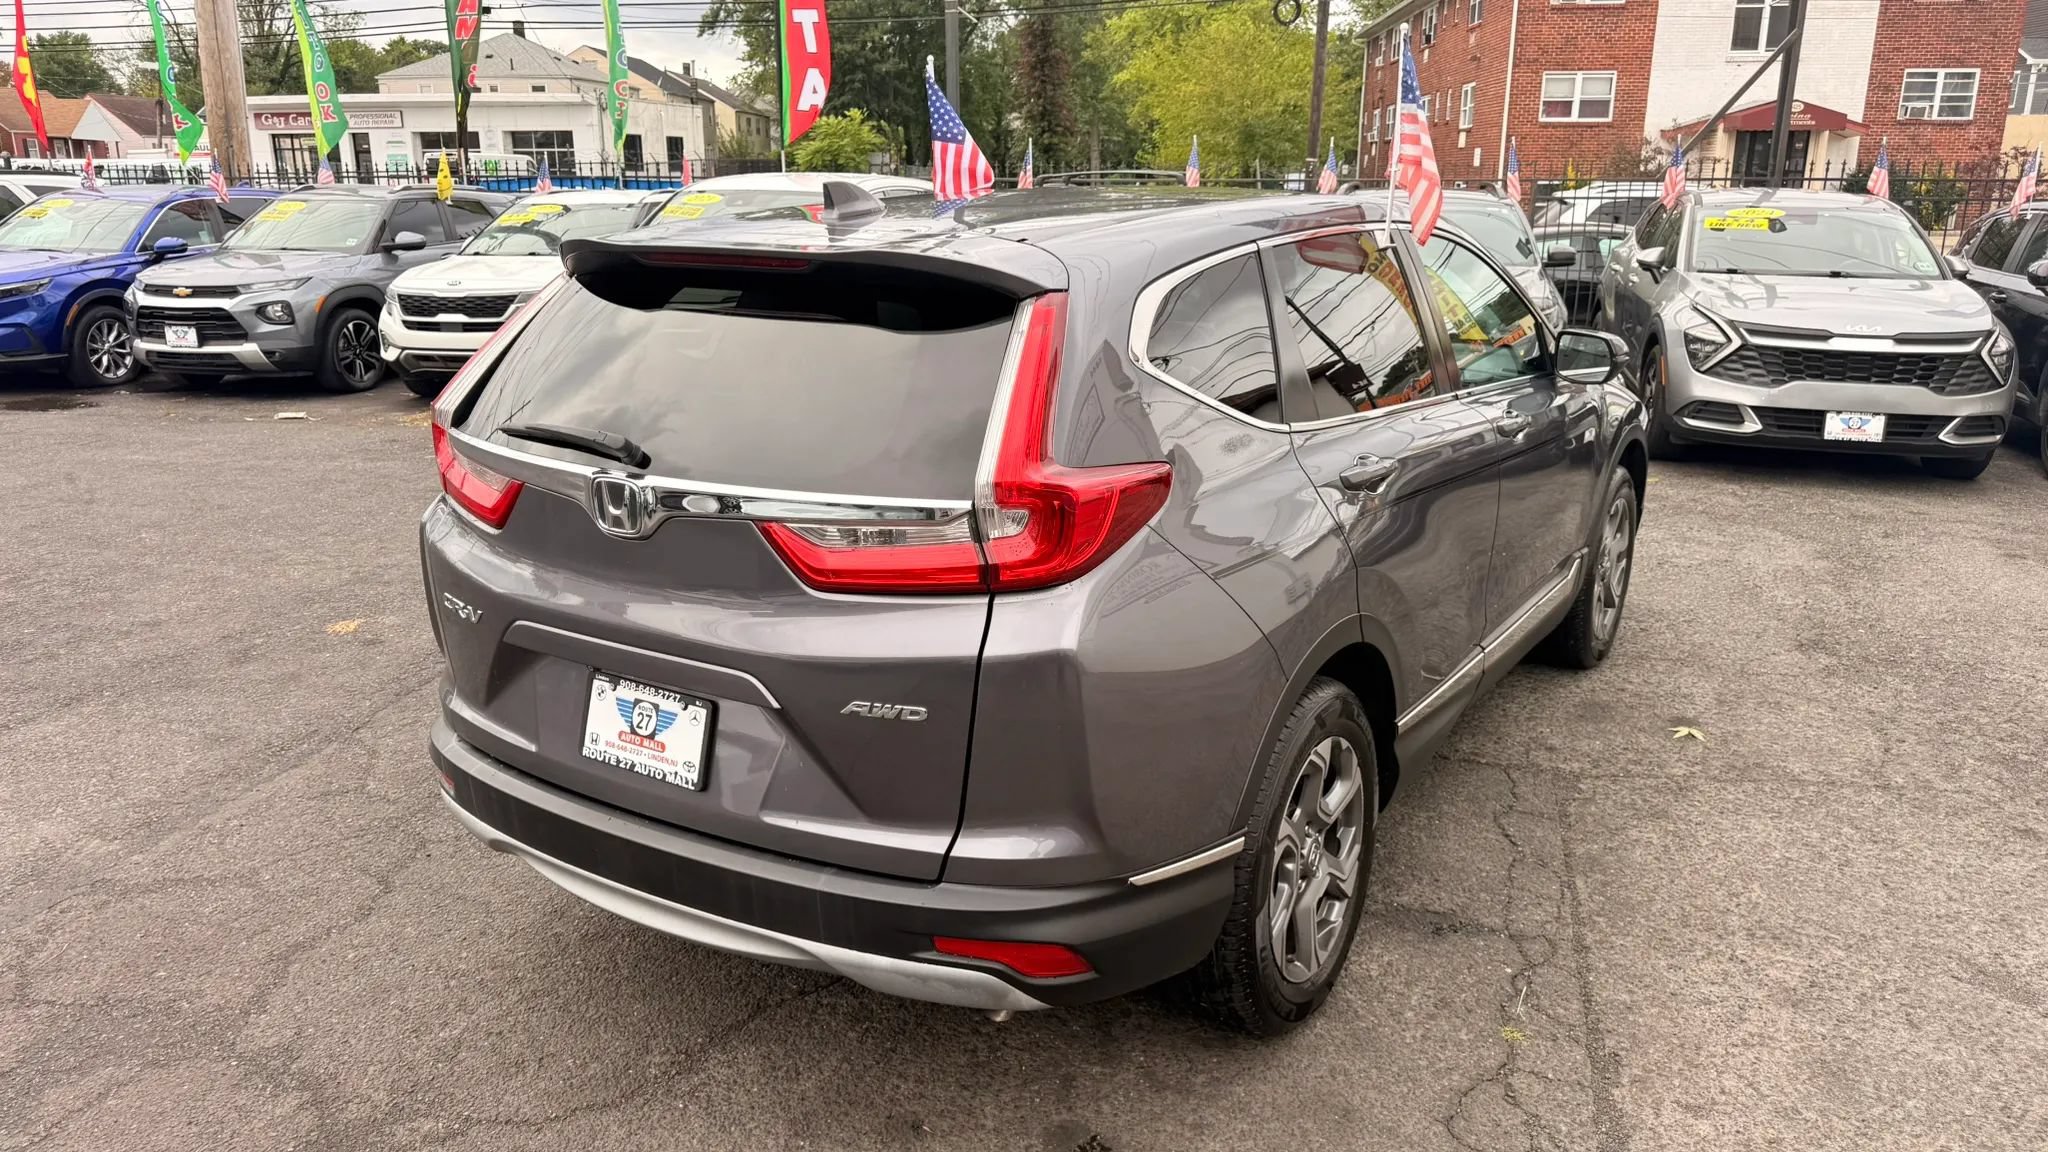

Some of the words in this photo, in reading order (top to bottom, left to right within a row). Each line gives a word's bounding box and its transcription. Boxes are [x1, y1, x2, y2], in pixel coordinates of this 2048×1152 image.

[791, 8, 827, 112] TA
[315, 81, 338, 122] OK
[350, 112, 397, 120] PROFESSIONAL
[1736, 221, 1765, 229] NEW
[619, 679, 681, 703] 908-648-2727
[638, 704, 654, 714] ROUTE
[840, 700, 928, 721] AWD
[635, 711, 653, 731] 27
[604, 740, 643, 757] 908-648-2727
[620, 732, 641, 746] AUTO
[642, 739, 664, 751] MALL
[582, 746, 618, 765] ROUTE
[618, 757, 632, 769] 27
[633, 762, 664, 780] AUTO
[665, 771, 696, 790] MALL
